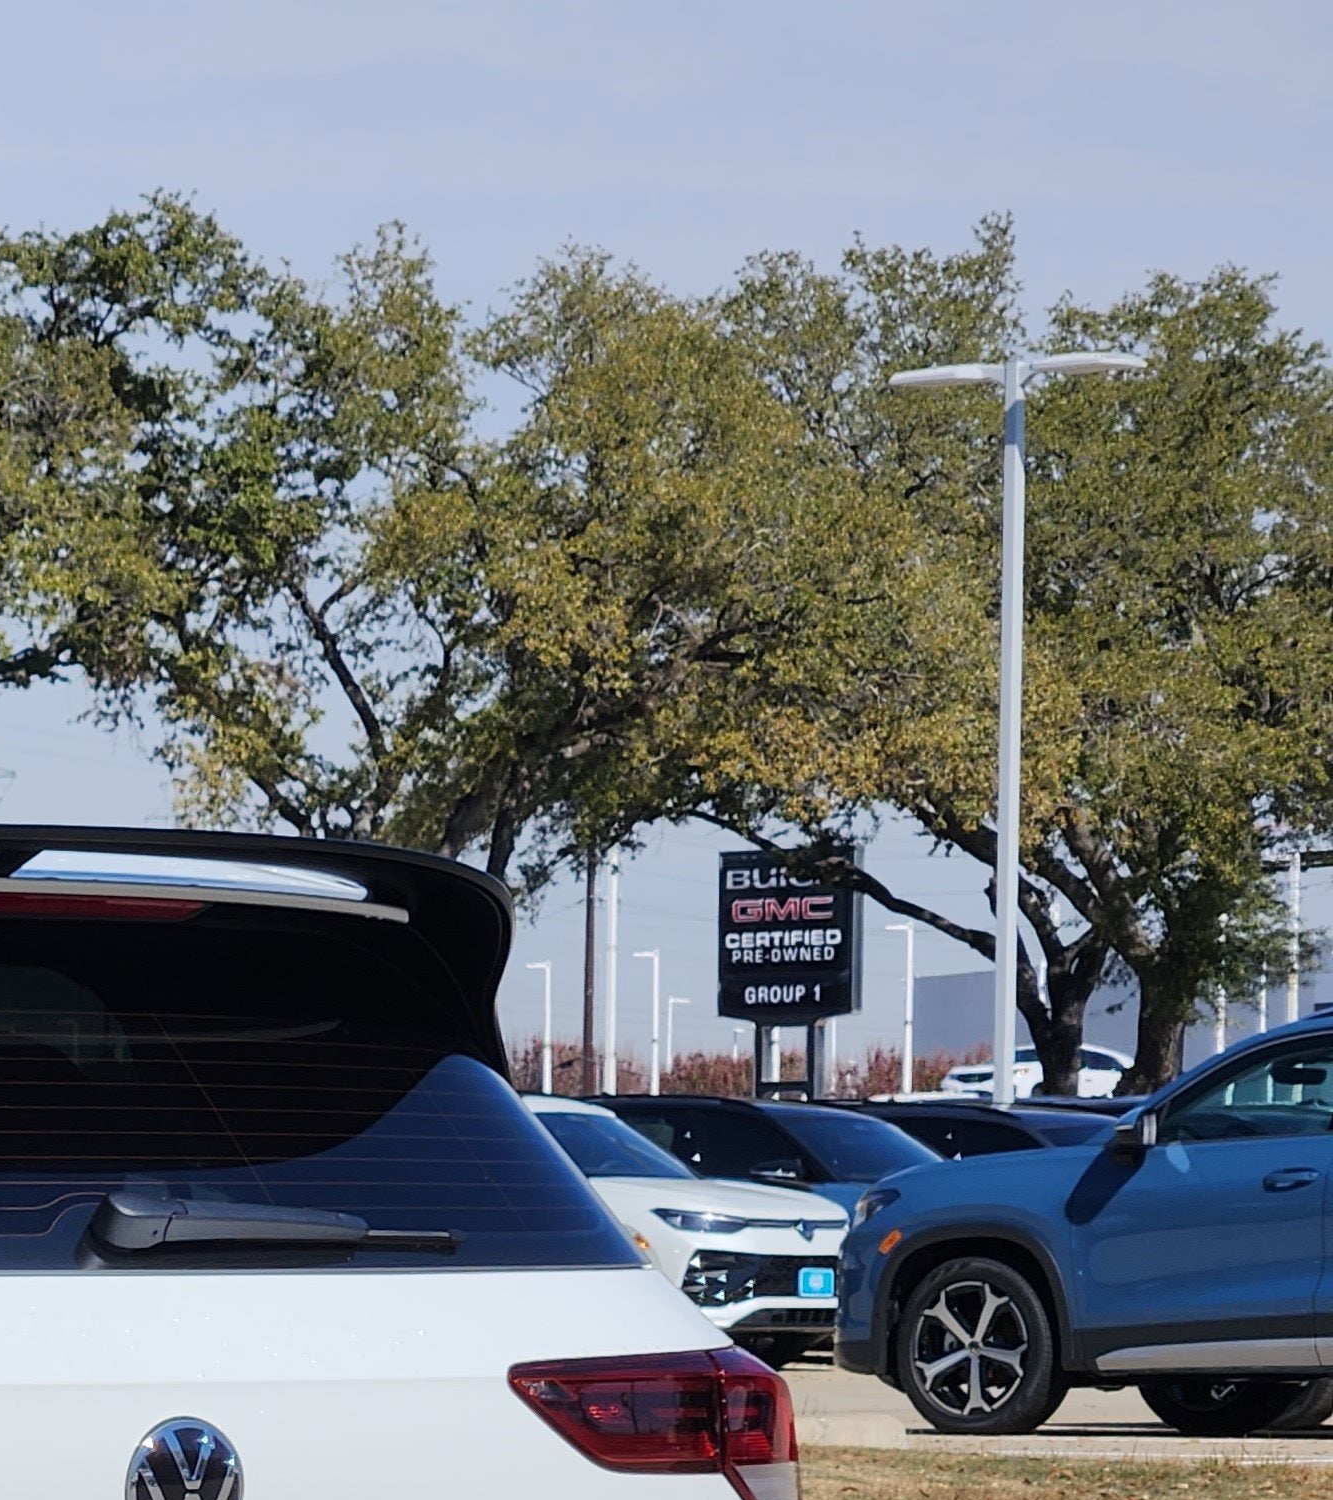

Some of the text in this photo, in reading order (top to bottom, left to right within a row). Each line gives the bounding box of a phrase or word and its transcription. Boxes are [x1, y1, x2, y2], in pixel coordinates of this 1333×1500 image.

[726, 866, 821, 890] BUI
[732, 895, 834, 923] GMC
[725, 928, 842, 949] CERTIFIED
[732, 946, 835, 963] PRE-OWNED
[745, 984, 821, 1004] GROUP 1
